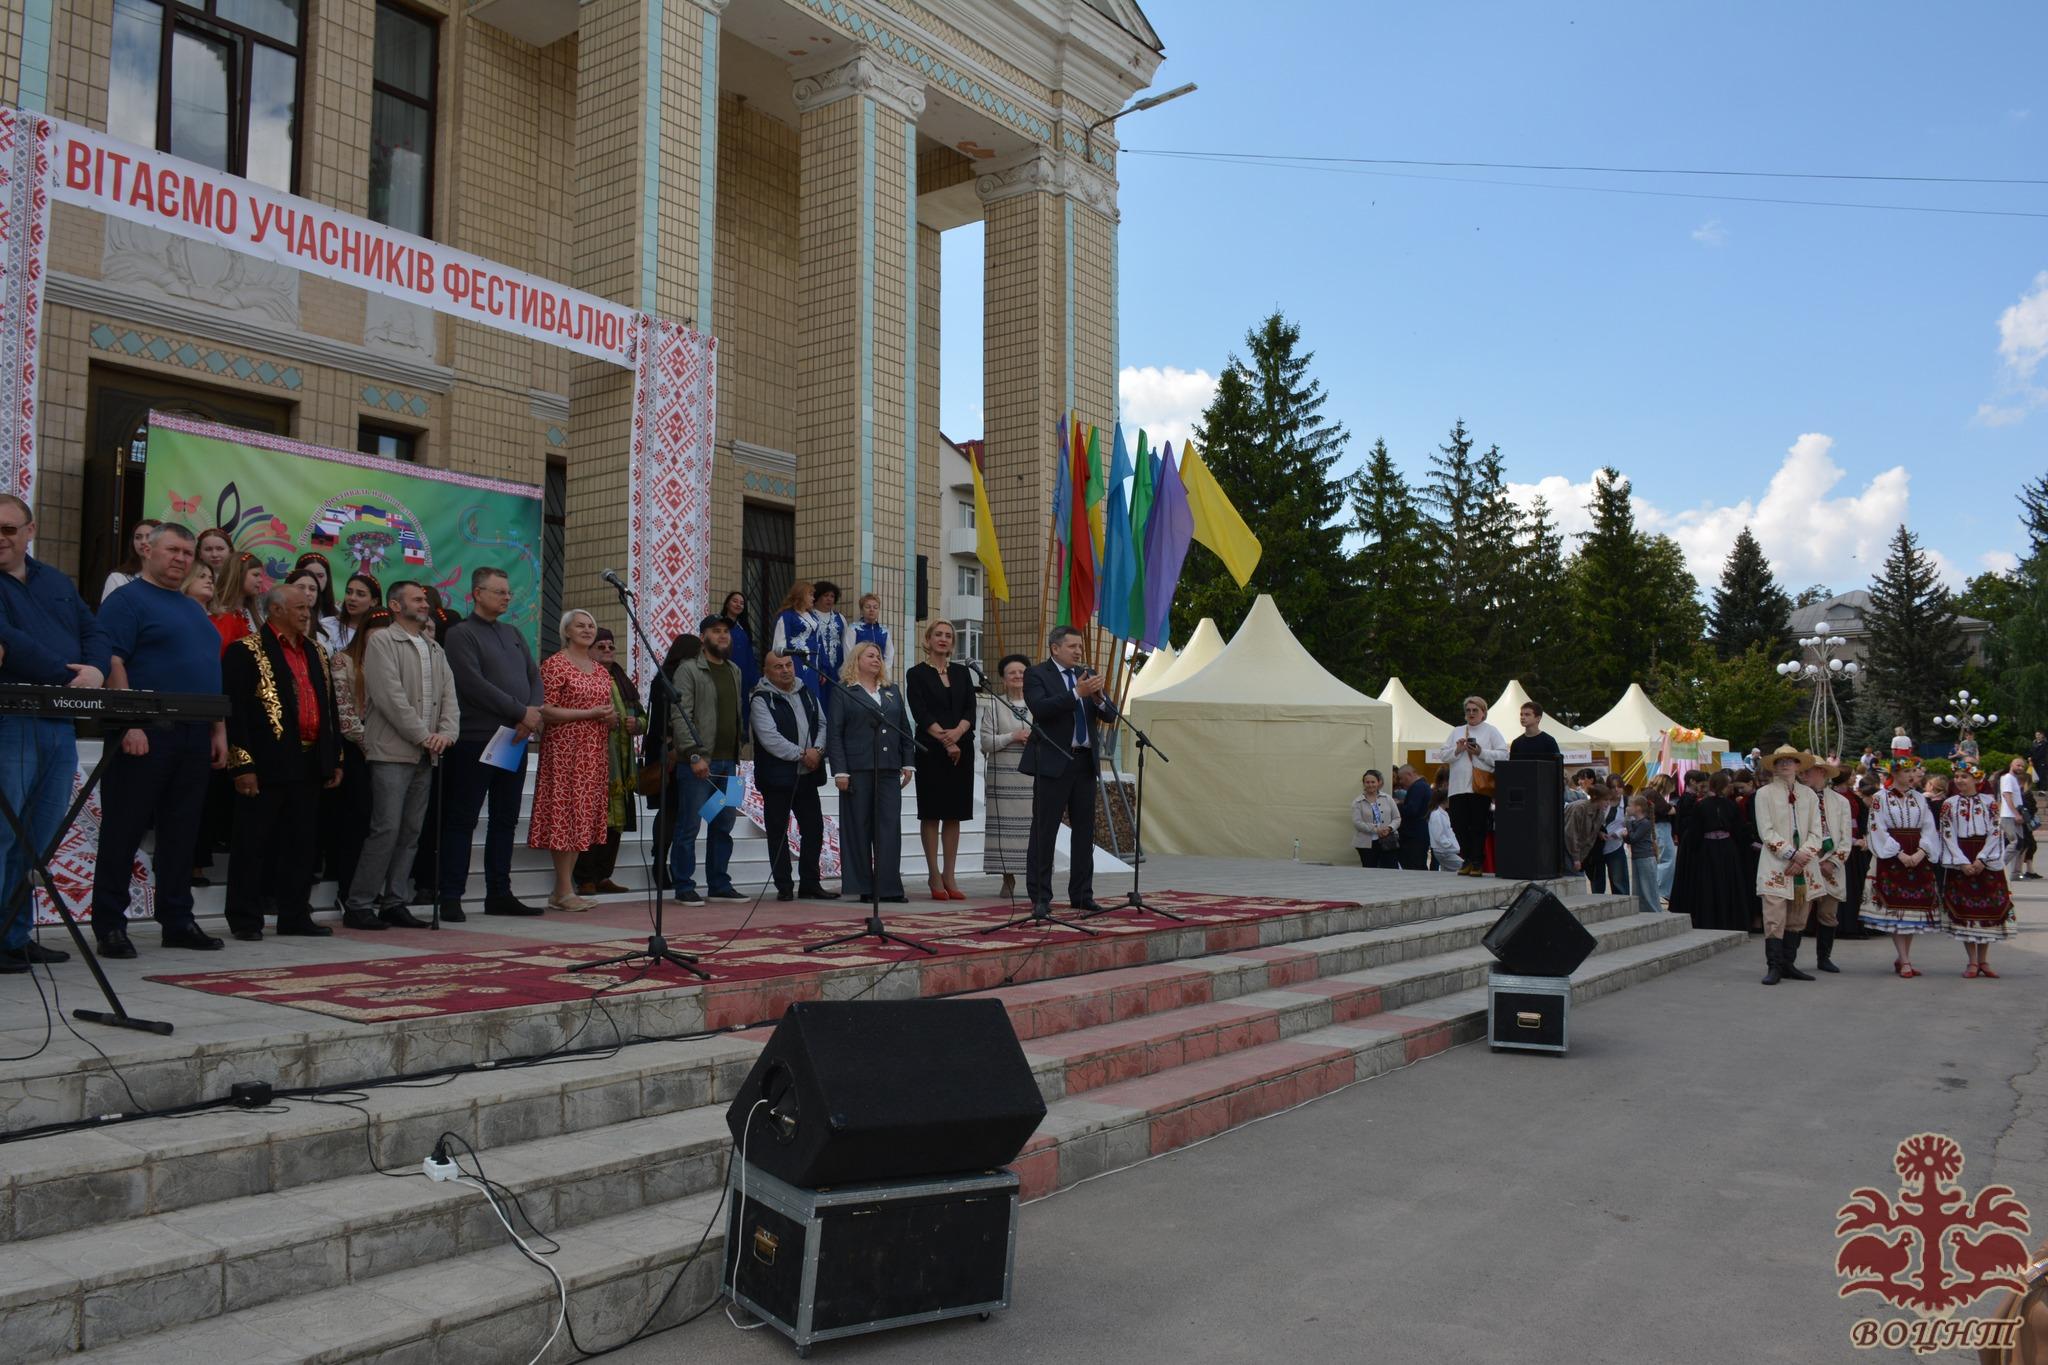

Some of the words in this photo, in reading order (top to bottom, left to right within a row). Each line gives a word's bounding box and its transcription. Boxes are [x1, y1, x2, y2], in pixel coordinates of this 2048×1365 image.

[66, 139, 238, 235] ВІТАЄМО
[249, 196, 435, 294] УЧАСНИКІВ
[443, 263, 625, 353] ФЕСТИВАЛЮ!
[53, 697, 104, 710] viscount
